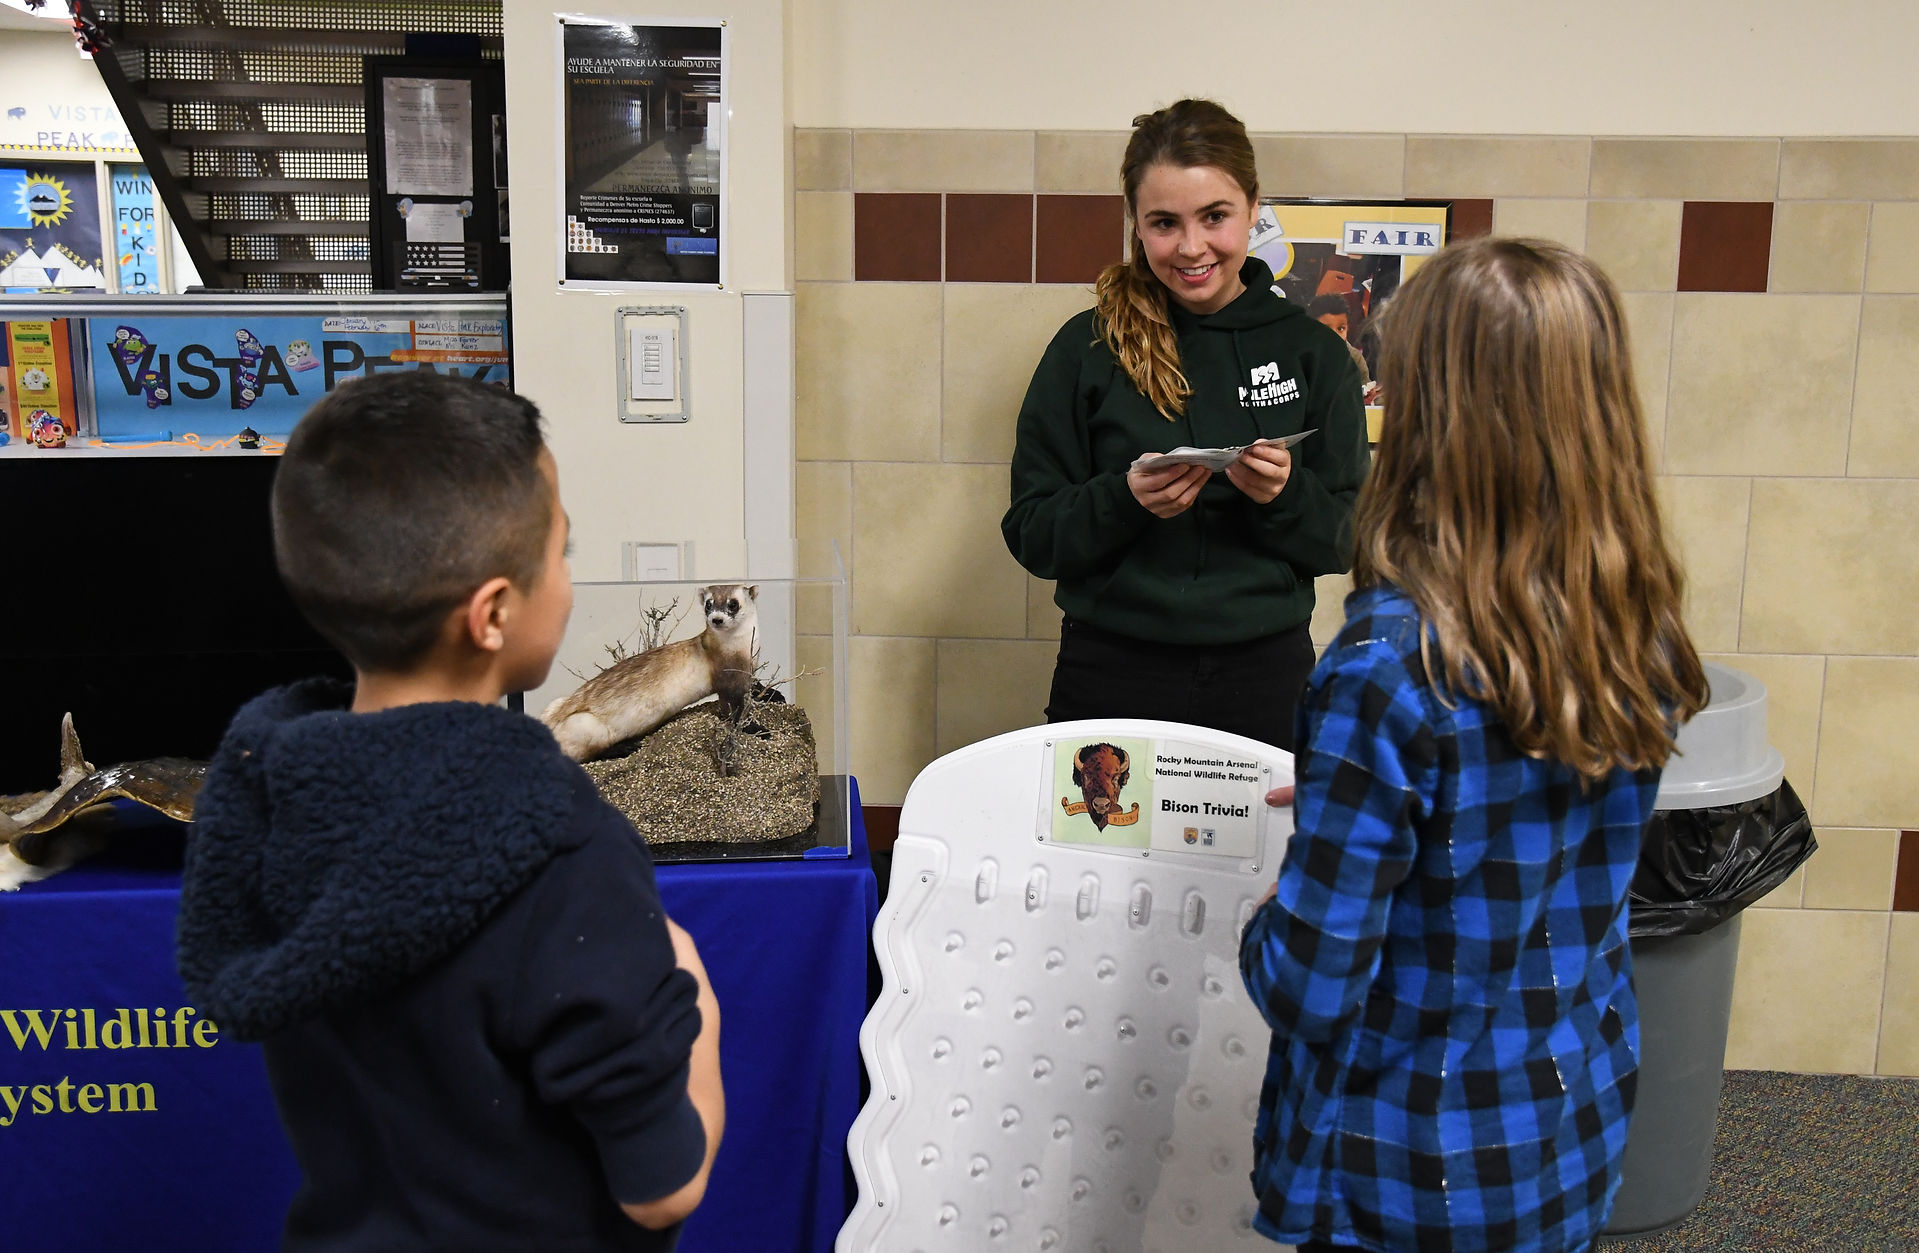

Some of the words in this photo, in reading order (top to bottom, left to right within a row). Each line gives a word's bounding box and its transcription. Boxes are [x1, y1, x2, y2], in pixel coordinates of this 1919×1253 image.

[567, 57, 593, 66] AYUDE
[603, 59, 646, 68] MANTENER
[659, 60, 704, 68] SEGURIDAD
[706, 61, 717, 69] EN
[580, 66, 615, 74] ESCUELA
[48, 104, 118, 122] VISTA
[37, 131, 95, 149] PEAK
[673, 185, 713, 194] ANNIMO
[1348, 228, 1435, 247] FAIR
[107, 343, 299, 410] VISTA
[1156, 754, 1182, 766] Rocky
[1183, 756, 1224, 768] Mountain
[1226, 758, 1258, 769] Arsenal
[1155, 767, 1192, 778] National
[1193, 769, 1227, 780] Wildlife
[1228, 771, 1259, 783] Refuge
[1161, 798, 1199, 814] Bison
[1202, 801, 1249, 818] Trivia!
[0, 1006, 219, 1052] Wildlife
